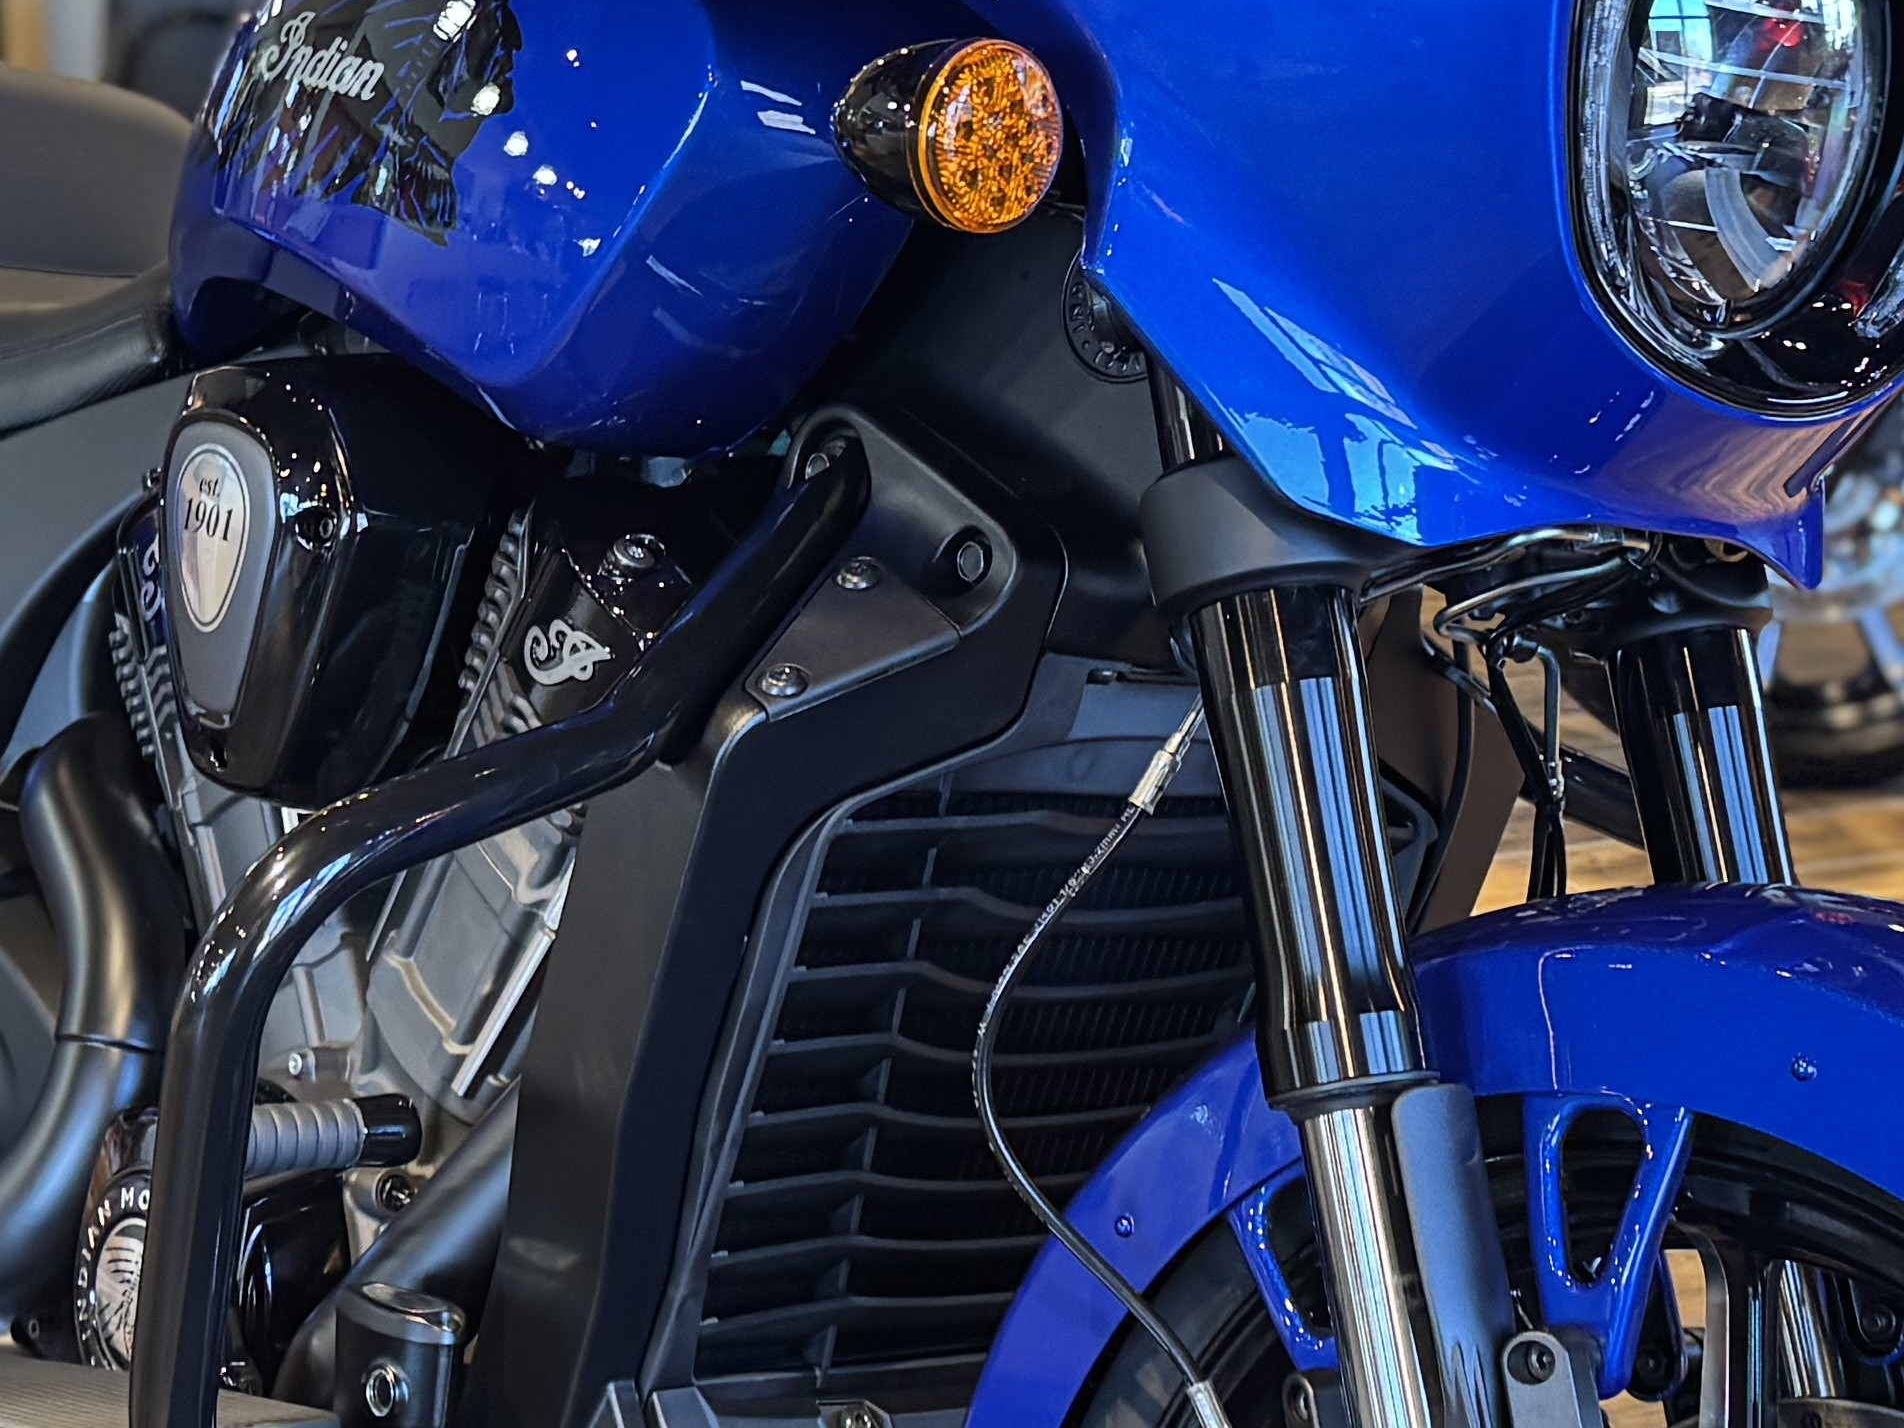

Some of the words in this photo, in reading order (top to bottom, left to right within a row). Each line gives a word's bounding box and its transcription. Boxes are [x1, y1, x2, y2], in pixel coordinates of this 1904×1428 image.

[259, 11, 385, 101] Indian
[199, 478, 221, 498] est.
[184, 495, 234, 541] 1901
